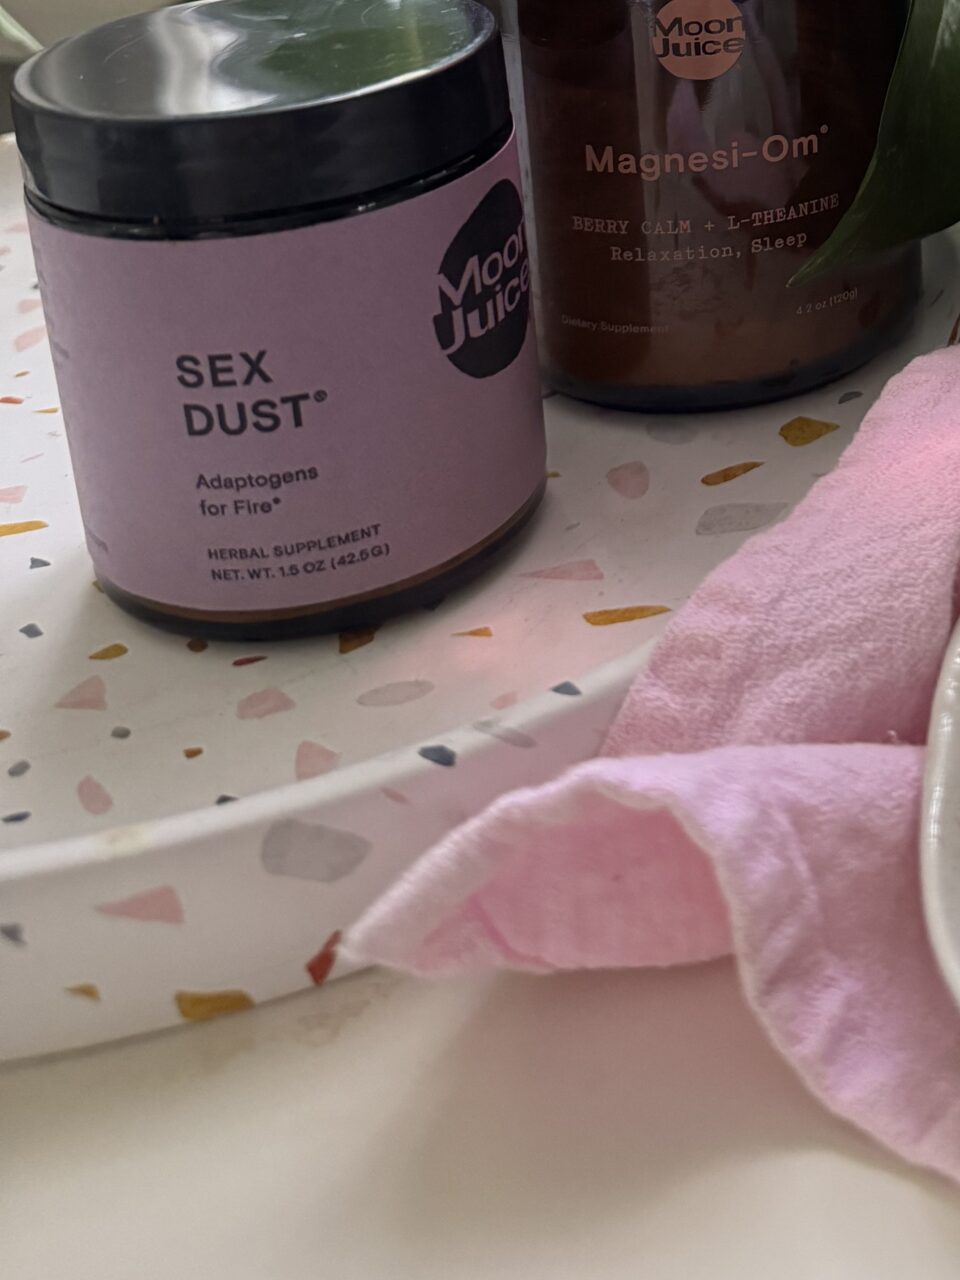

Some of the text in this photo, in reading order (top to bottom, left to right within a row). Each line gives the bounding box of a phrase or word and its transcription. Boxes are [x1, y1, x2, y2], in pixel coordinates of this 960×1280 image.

[653, 16, 745, 37] Moon
[654, 37, 745, 58] Juice
[571, 193, 840, 235] BERRY CALM + L-THEANINE
[609, 231, 807, 263] Relaxation, Sleep
[442, 257, 530, 355] Juice
[175, 348, 275, 389] SEX
[195, 466, 320, 493] Adaptogens
[199, 499, 229, 517] for
[208, 523, 382, 561] HERBAL SUPPLEMENT
[210, 542, 392, 581] NET. WT. 1.5 OZ (42.5G)
